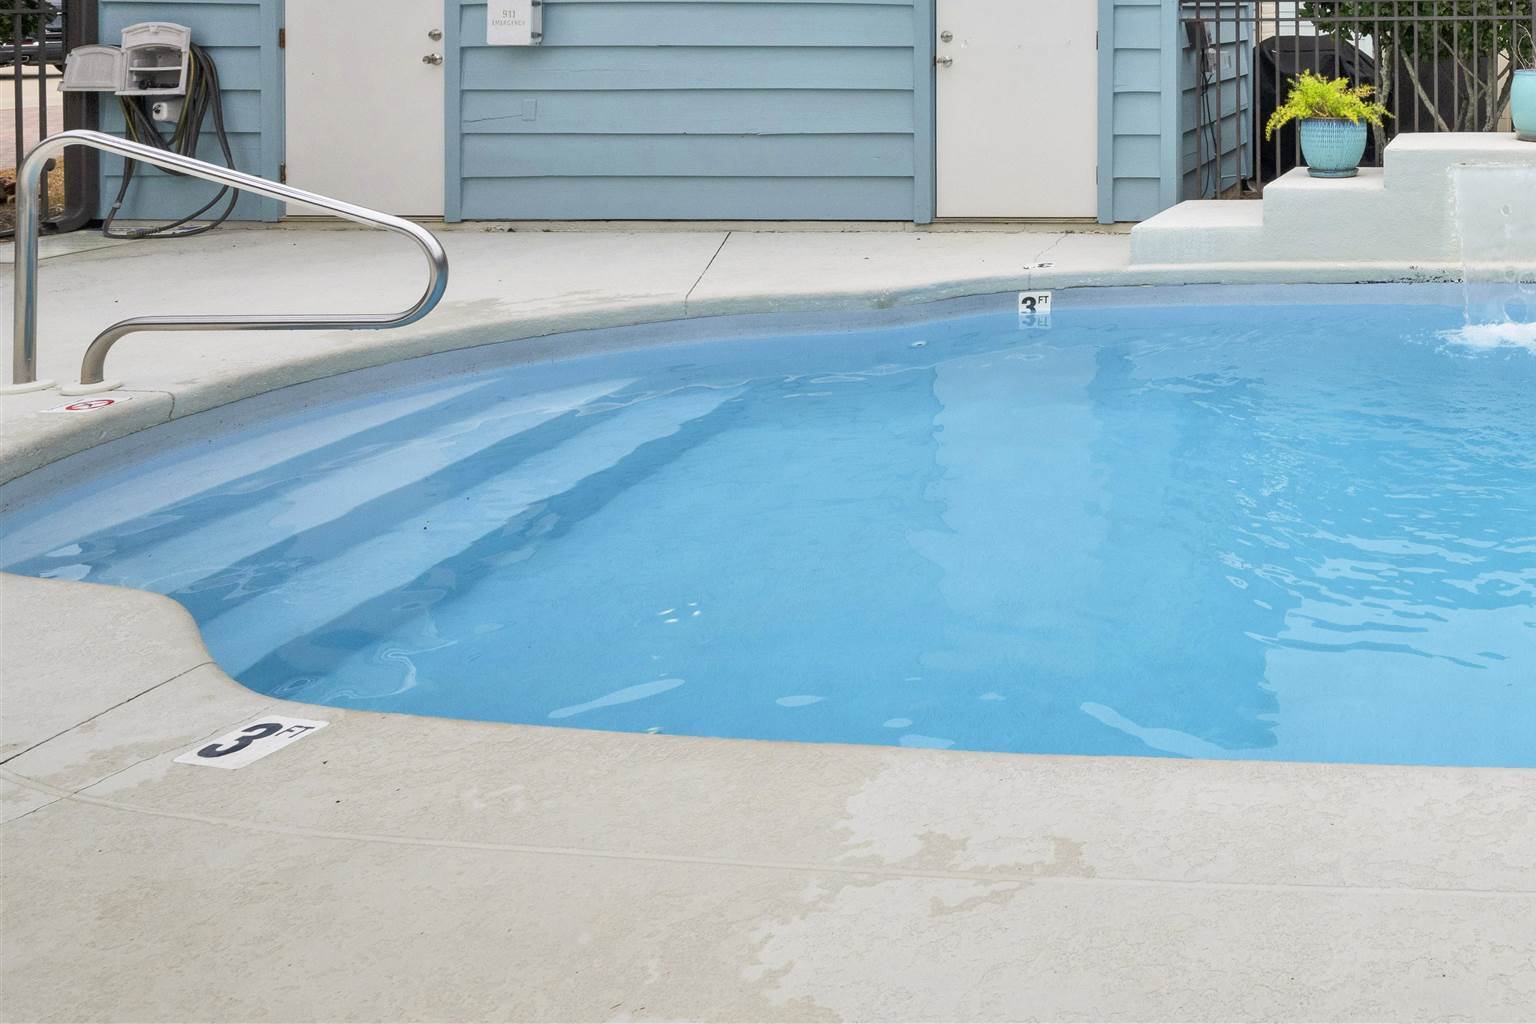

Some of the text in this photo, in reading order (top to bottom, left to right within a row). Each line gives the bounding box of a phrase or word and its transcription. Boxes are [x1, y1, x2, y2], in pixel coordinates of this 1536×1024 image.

[502, 10, 516, 18] 911
[1021, 295, 1049, 314] 3 FT
[197, 723, 315, 758] 3 FT
